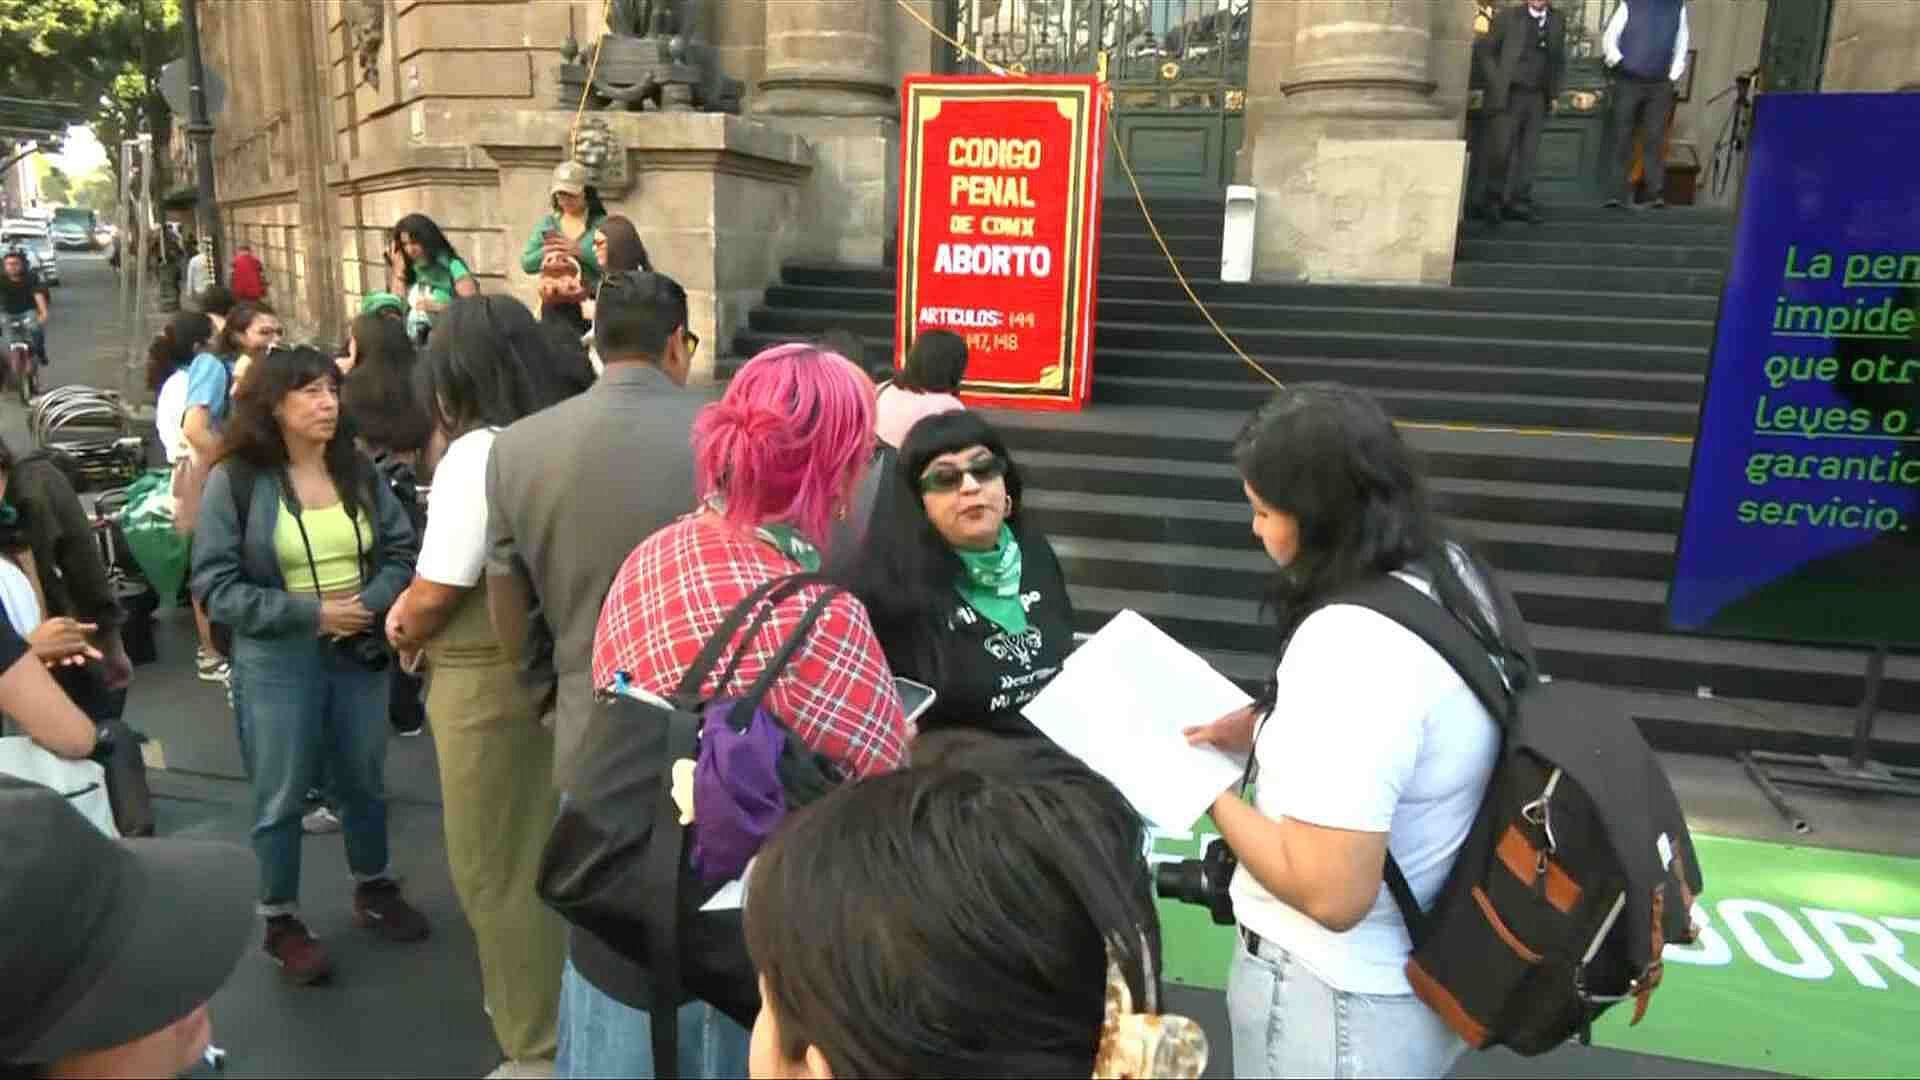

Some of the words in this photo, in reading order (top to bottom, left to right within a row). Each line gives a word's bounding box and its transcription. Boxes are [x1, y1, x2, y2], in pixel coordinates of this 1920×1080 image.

[948, 137, 1041, 169] CODIGO
[950, 176, 1035, 207] PENAL
[950, 214, 975, 235] DE
[981, 214, 1036, 238] CDMX
[933, 243, 1051, 277] ABORTO
[1784, 246, 1832, 279] La
[919, 307, 1004, 327] ARTICULOS:
[1773, 297, 1914, 336] impide
[1764, 356, 1838, 387] que
[1882, 409, 1907, 433] o
[1737, 497, 1907, 530] servicio.
